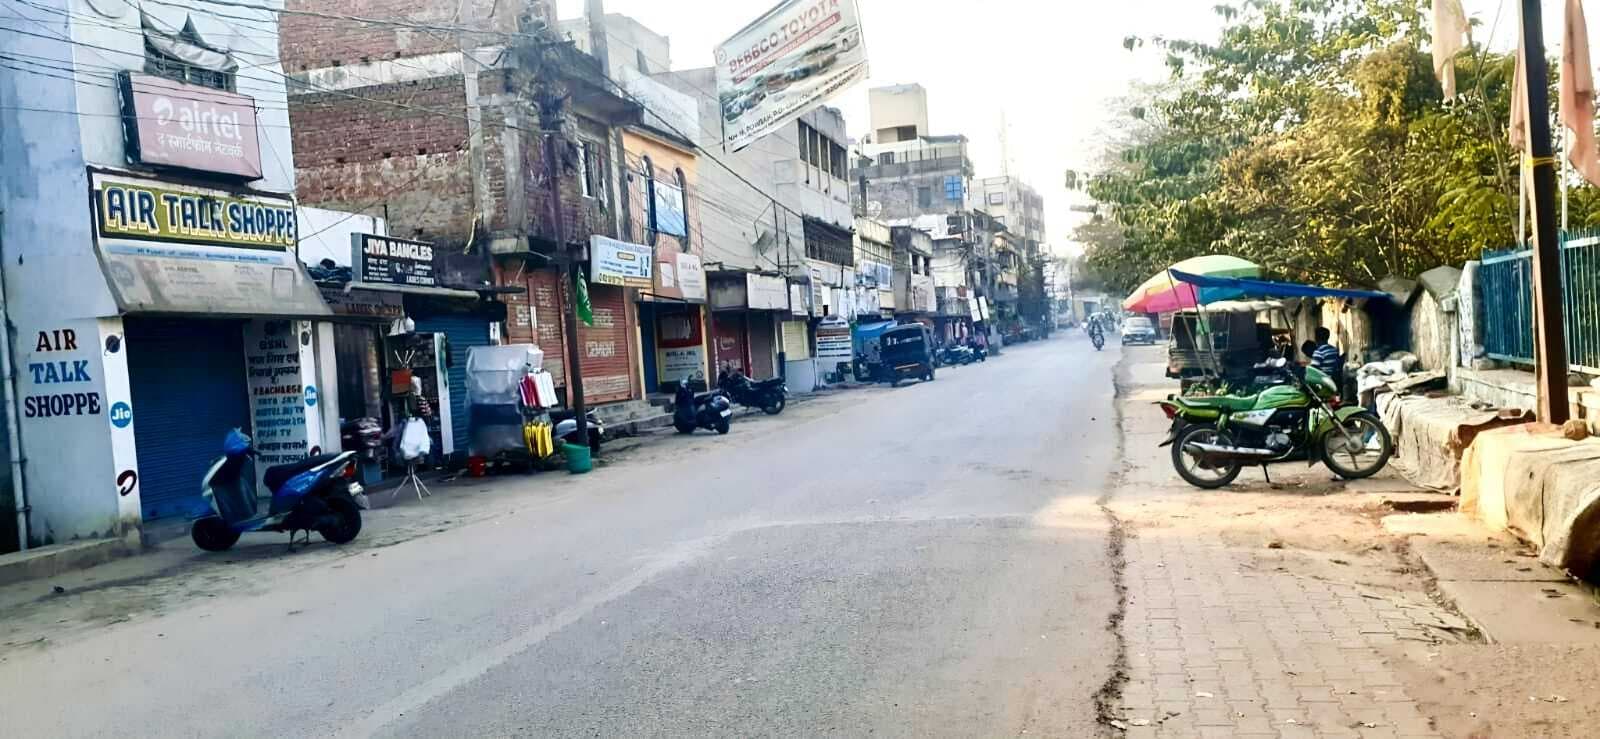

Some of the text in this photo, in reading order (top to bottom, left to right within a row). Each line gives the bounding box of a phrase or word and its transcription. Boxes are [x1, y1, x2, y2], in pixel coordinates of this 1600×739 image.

[780, 0, 840, 40] TOYOTA
[180, 100, 242, 140] airtel
[104, 187, 295, 245] AIR TALK SHOPPE
[364, 238, 433, 261] JIYA BANGLES
[36, 329, 77, 352] AIR
[29, 360, 91, 385] TALK
[24, 393, 100, 418] SHOPPE
[305, 390, 316, 399] Jio
[112, 408, 131, 420] Jio
[280, 429, 291, 437] TV
